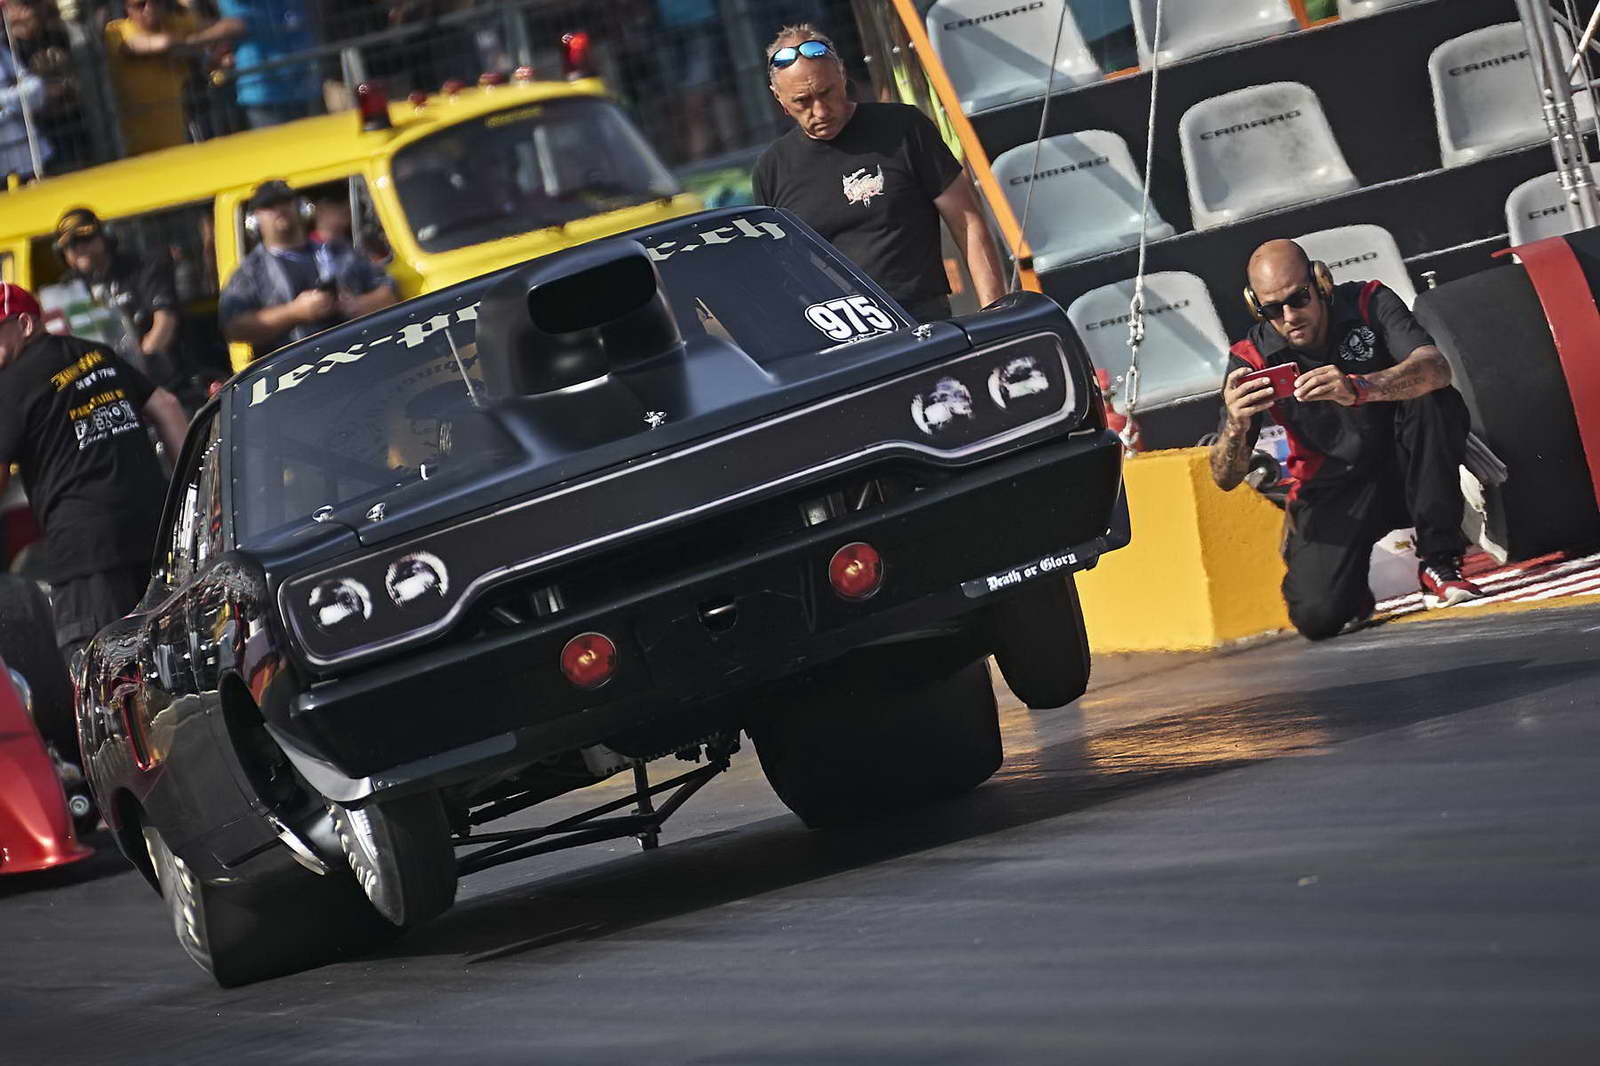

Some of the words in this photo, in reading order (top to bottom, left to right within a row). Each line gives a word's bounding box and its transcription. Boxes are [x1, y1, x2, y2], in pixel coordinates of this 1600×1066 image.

[943, 1, 1044, 31] CAMARO
[1448, 49, 1530, 77] CAMAR
[1200, 109, 1301, 141] CAMARO
[1009, 155, 1109, 186] CAMARO
[807, 296, 893, 339] 975
[986, 569, 1022, 592] Death
[1023, 565, 1038, 578] or
[1039, 553, 1077, 572] Glory
